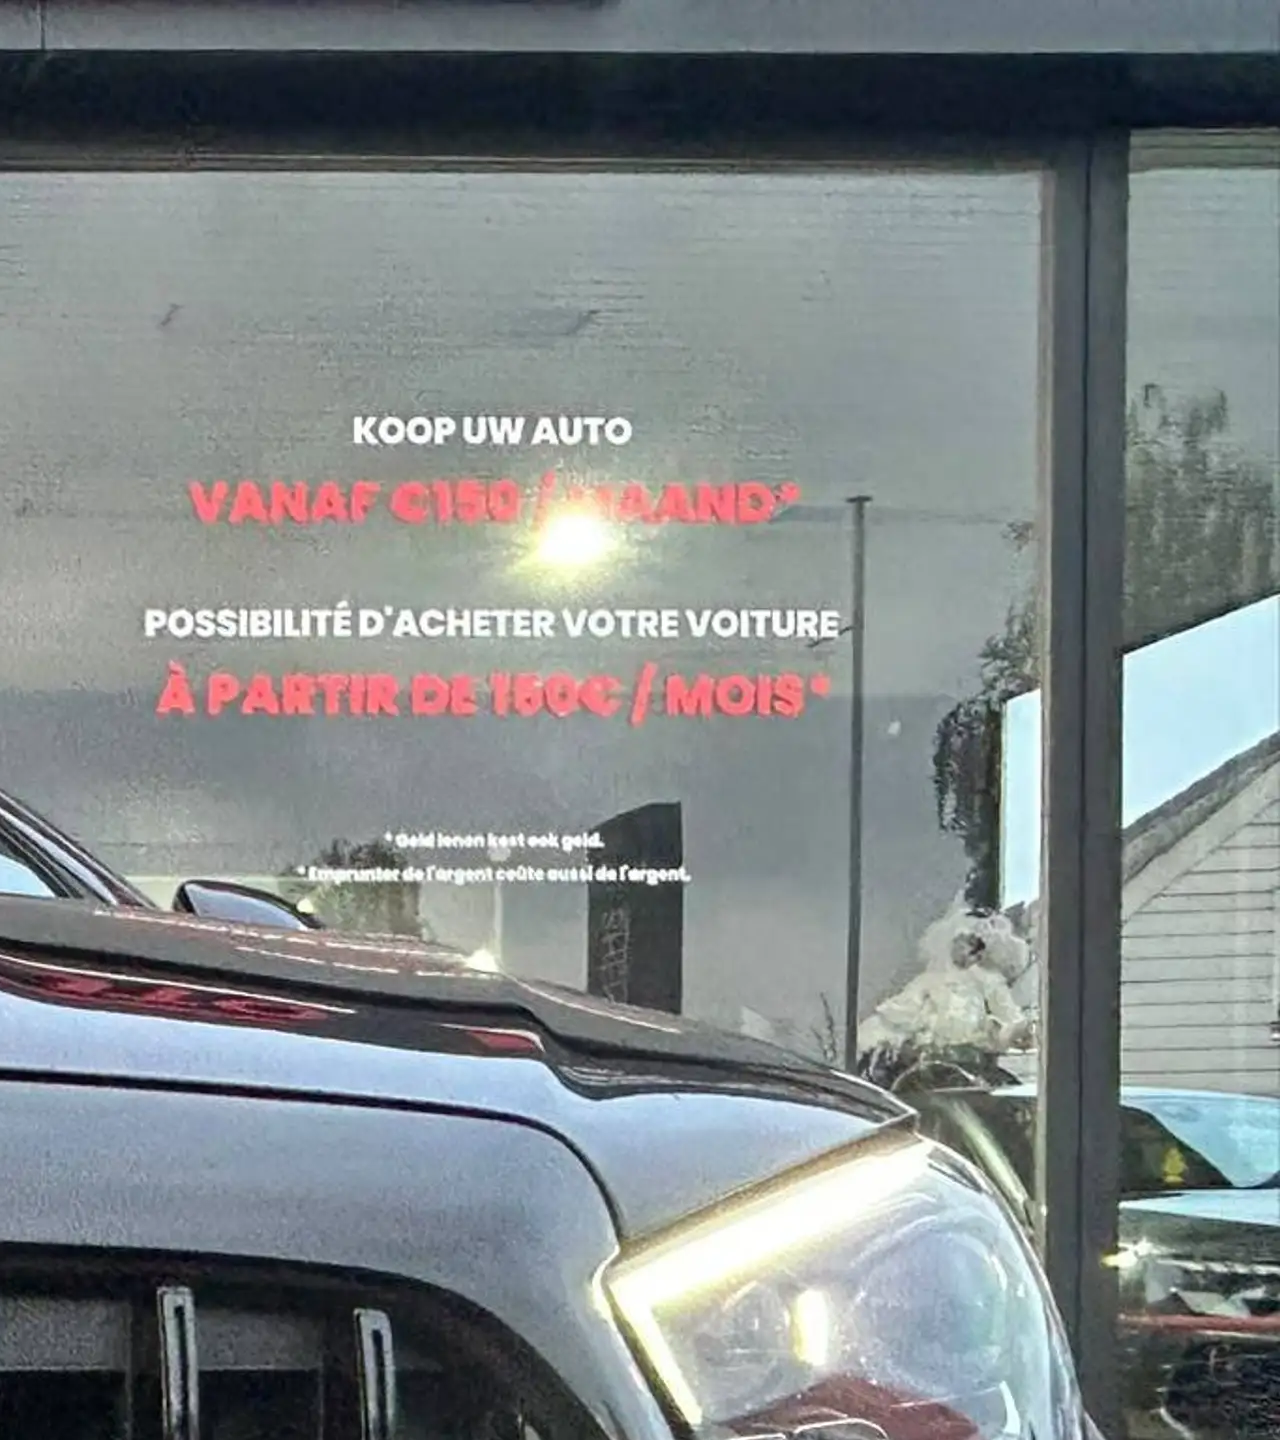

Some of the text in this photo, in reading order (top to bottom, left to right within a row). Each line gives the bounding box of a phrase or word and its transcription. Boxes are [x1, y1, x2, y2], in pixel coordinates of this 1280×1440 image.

[353, 416, 633, 445] KOOP UW AUTO
[190, 480, 381, 525] VANAF
[144, 601, 841, 639] POSSIBILITÉ D'ACHETER VOTRE VOITURE
[156, 660, 196, 716] À
[206, 672, 400, 717] PARTIR
[410, 672, 476, 717] DE
[489, 672, 622, 717] 150€
